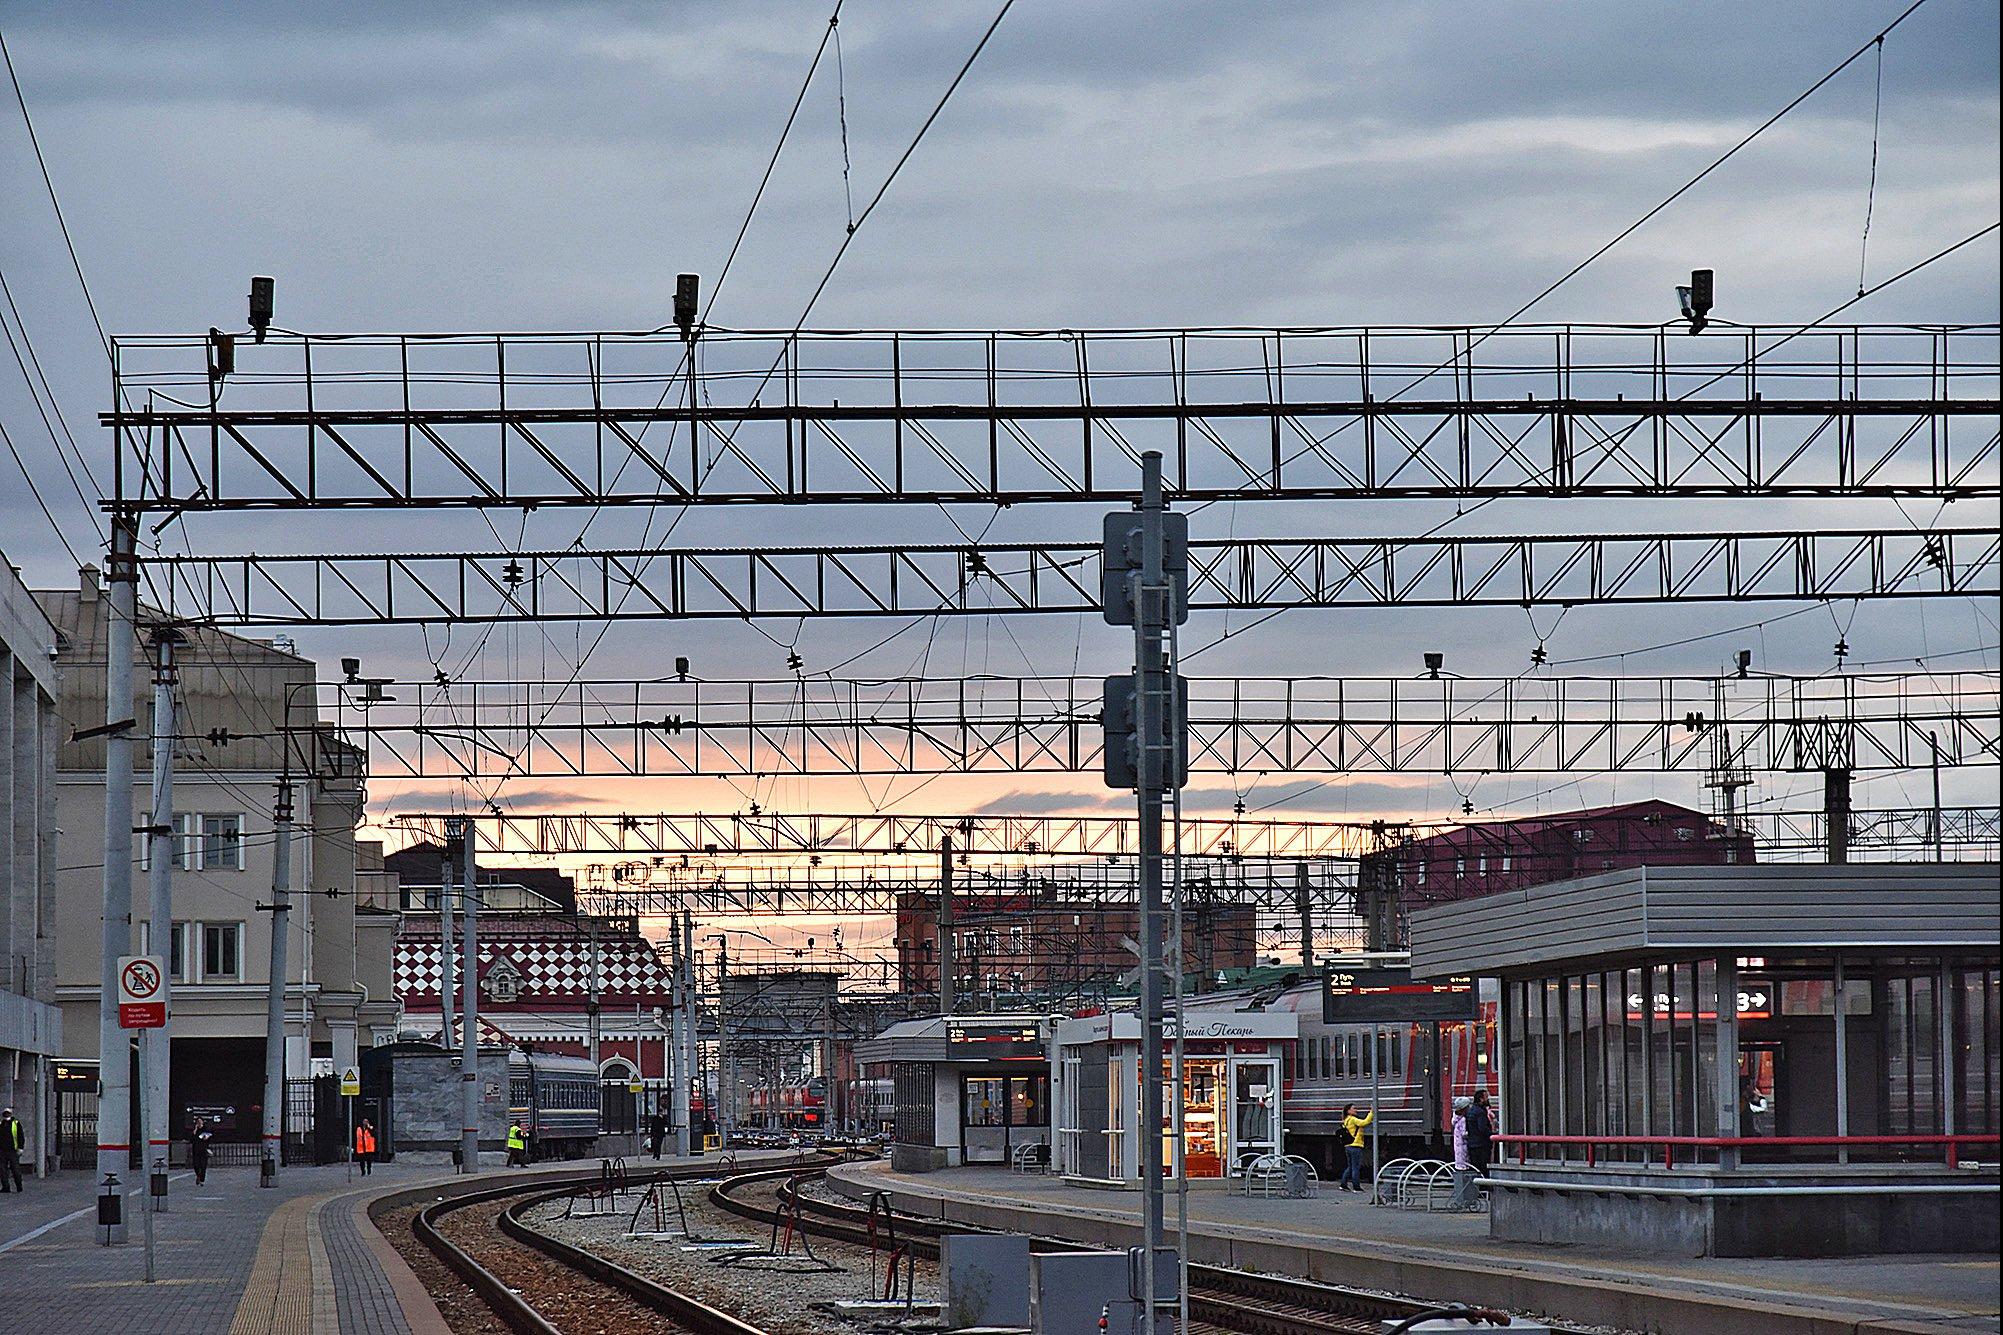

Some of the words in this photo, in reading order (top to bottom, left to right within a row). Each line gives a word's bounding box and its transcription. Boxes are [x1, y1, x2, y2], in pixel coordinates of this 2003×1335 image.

[1330, 974, 1339, 986] 2
[1736, 992, 1750, 1011] 3
[1207, 1022, 1254, 1037] Пекарь
